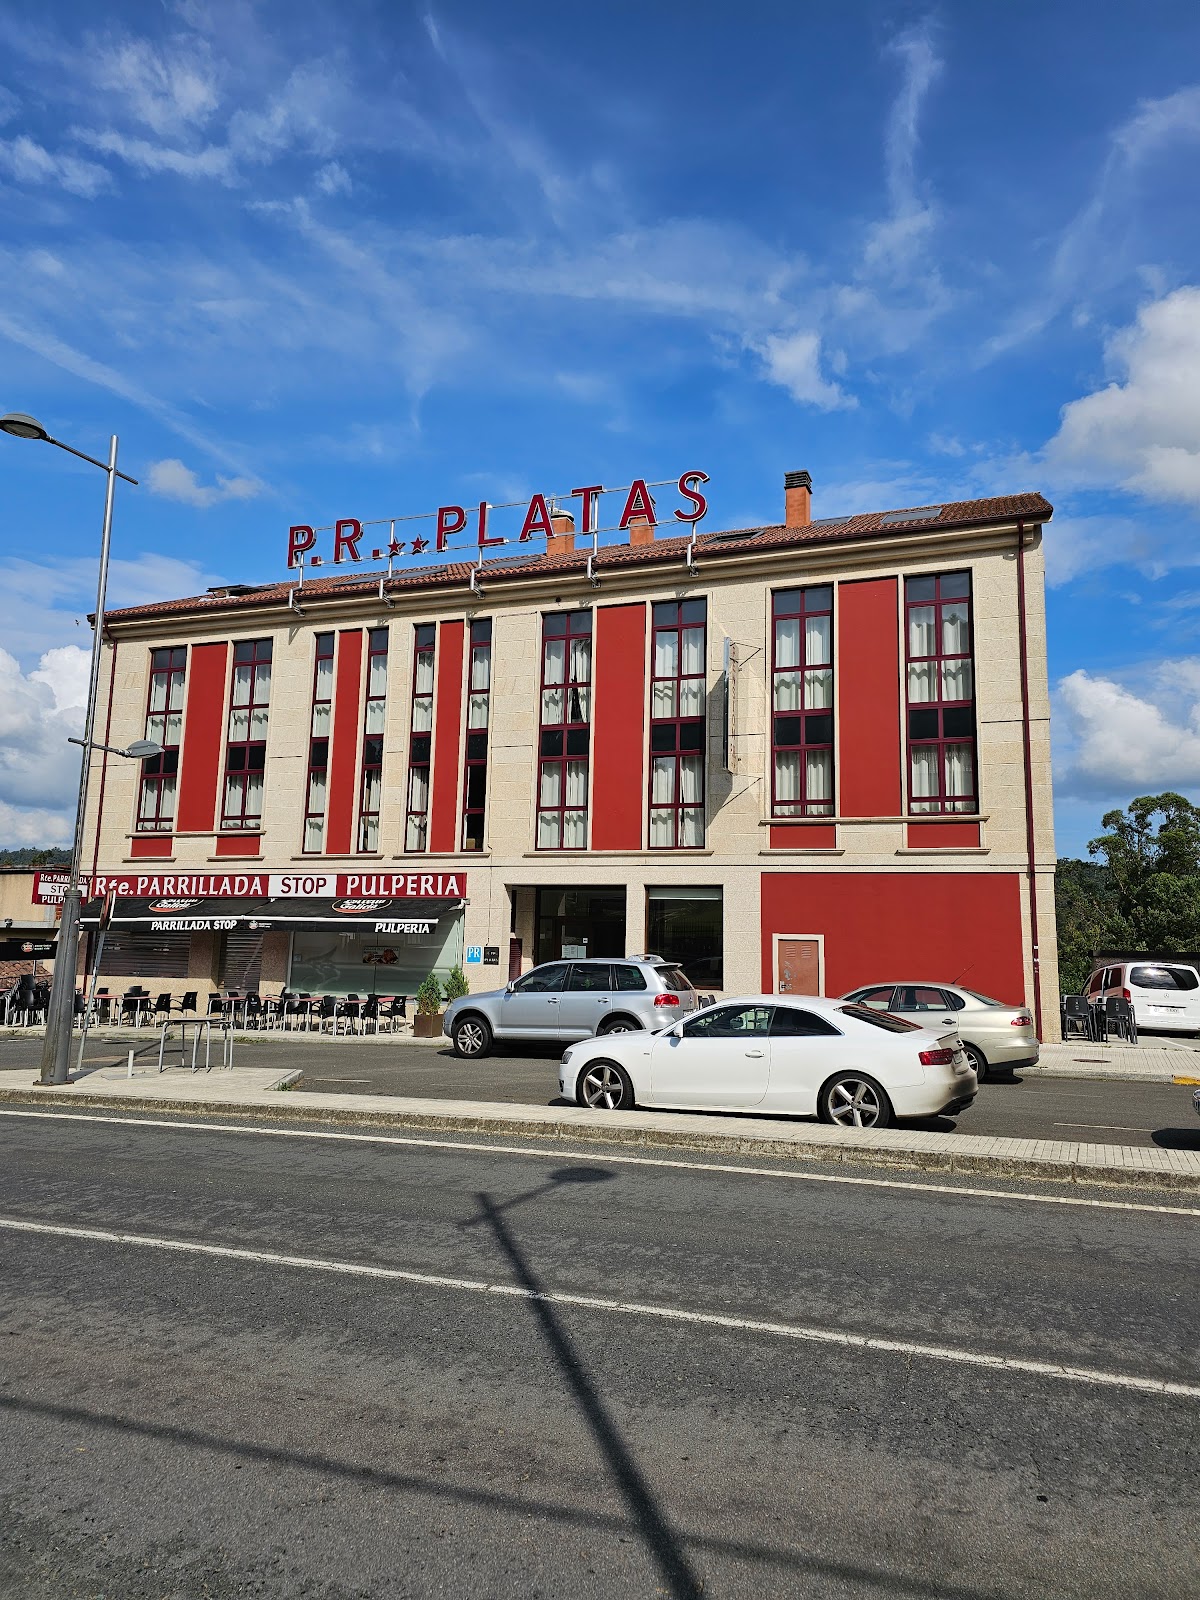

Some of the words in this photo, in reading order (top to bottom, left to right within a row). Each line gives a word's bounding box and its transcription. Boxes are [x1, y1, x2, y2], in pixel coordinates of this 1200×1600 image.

[436, 470, 710, 553] PLATAS
[50, 885, 70, 894] STO
[281, 876, 327, 895] STOP
[346, 875, 461, 896] PULPERIA
[150, 920, 211, 931] PARRILLADA
[213, 919, 238, 930] STOP
[374, 922, 431, 934] PULPERIA
[467, 947, 481, 958] PR
